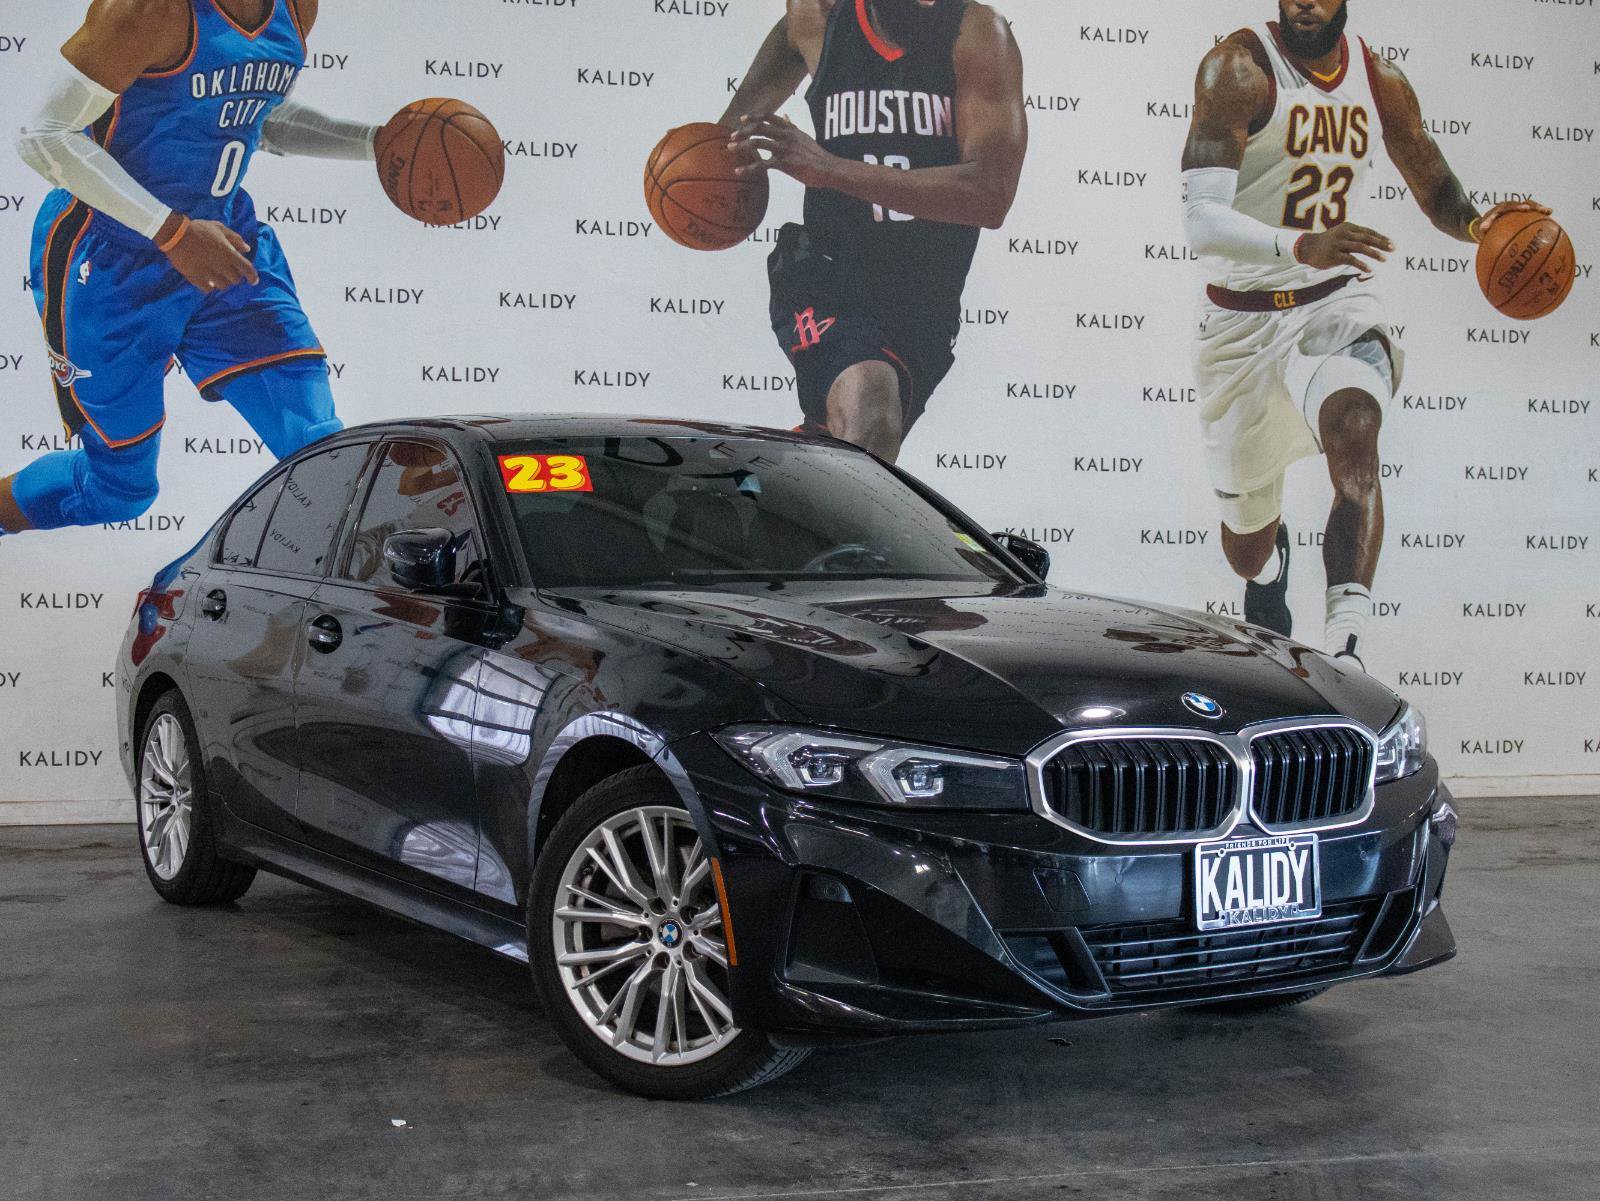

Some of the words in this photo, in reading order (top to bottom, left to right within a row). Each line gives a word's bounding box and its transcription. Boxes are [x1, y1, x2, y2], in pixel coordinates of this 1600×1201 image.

[655, 0, 728, 16] KALIDY
[1081, 26, 1148, 44] KALIDY
[303, 53, 349, 70] IDY
[426, 60, 502, 78] KALIDY
[1472, 53, 1533, 69] KALIDY
[578, 69, 654, 86] KALIDY
[1024, 95, 1080, 111] ALIDY
[1147, 102, 1196, 118] KALI
[219, 99, 267, 128] CITY
[825, 90, 953, 140] HOUSTON
[1284, 104, 1369, 160] CAVS
[1422, 119, 1471, 135] ALIDY
[1533, 126, 1593, 142] KALIDY
[501, 140, 578, 158] KALIDY
[1079, 170, 1146, 186] KALIDY
[1280, 164, 1355, 231] 23
[267, 207, 347, 225] KALIDY
[576, 219, 652, 237] KALIDY
[1009, 239, 1078, 255] KALIDY
[1406, 257, 1469, 272] KALIDY
[346, 287, 423, 304] KALIDY
[500, 292, 576, 309] KALIDY
[1273, 290, 1296, 309] CLE
[651, 298, 724, 314] KALIDY
[959, 309, 1009, 324] LIDY
[1077, 314, 1144, 329] KALIDY
[1468, 329, 1530, 344] KALIDY
[423, 366, 499, 382] KALIDY
[575, 371, 650, 387] KALIDY
[723, 375, 795, 391] KALIDY
[1008, 383, 1075, 398] KALIDY
[1143, 387, 1196, 402] KALID
[1404, 396, 1467, 410] KALIDY
[1529, 399, 1590, 413] KALIDY
[185, 438, 264, 454] KALIDY
[937, 454, 1006, 469] KALIDY
[1075, 457, 1142, 472] KALIDY
[503, 455, 586, 491] 23
[1466, 466, 1527, 480] KALIDY
[1005, 527, 1074, 542] ALIDY
[1141, 530, 1208, 544] KALIDY
[1298, 532, 1325, 545] LID
[1402, 534, 1464, 547] KALIDY
[1527, 536, 1588, 549] KALIDY
[21, 593, 103, 608] KALIDY
[1206, 601, 1241, 615] KAL
[1372, 602, 1401, 616] IDY
[1464, 604, 1525, 616] KALIDY
[1400, 672, 1462, 685] KALIDY
[1525, 672, 1585, 685] KALIDY
[1462, 740, 1523, 753] KALIDY
[20, 751, 102, 766] KALIDY
[1225, 840, 1256, 849] FRIENDS
[1259, 839, 1272, 847] FOR
[1202, 849, 1309, 914] KALIDY
[1230, 905, 1290, 925] KALIDY
